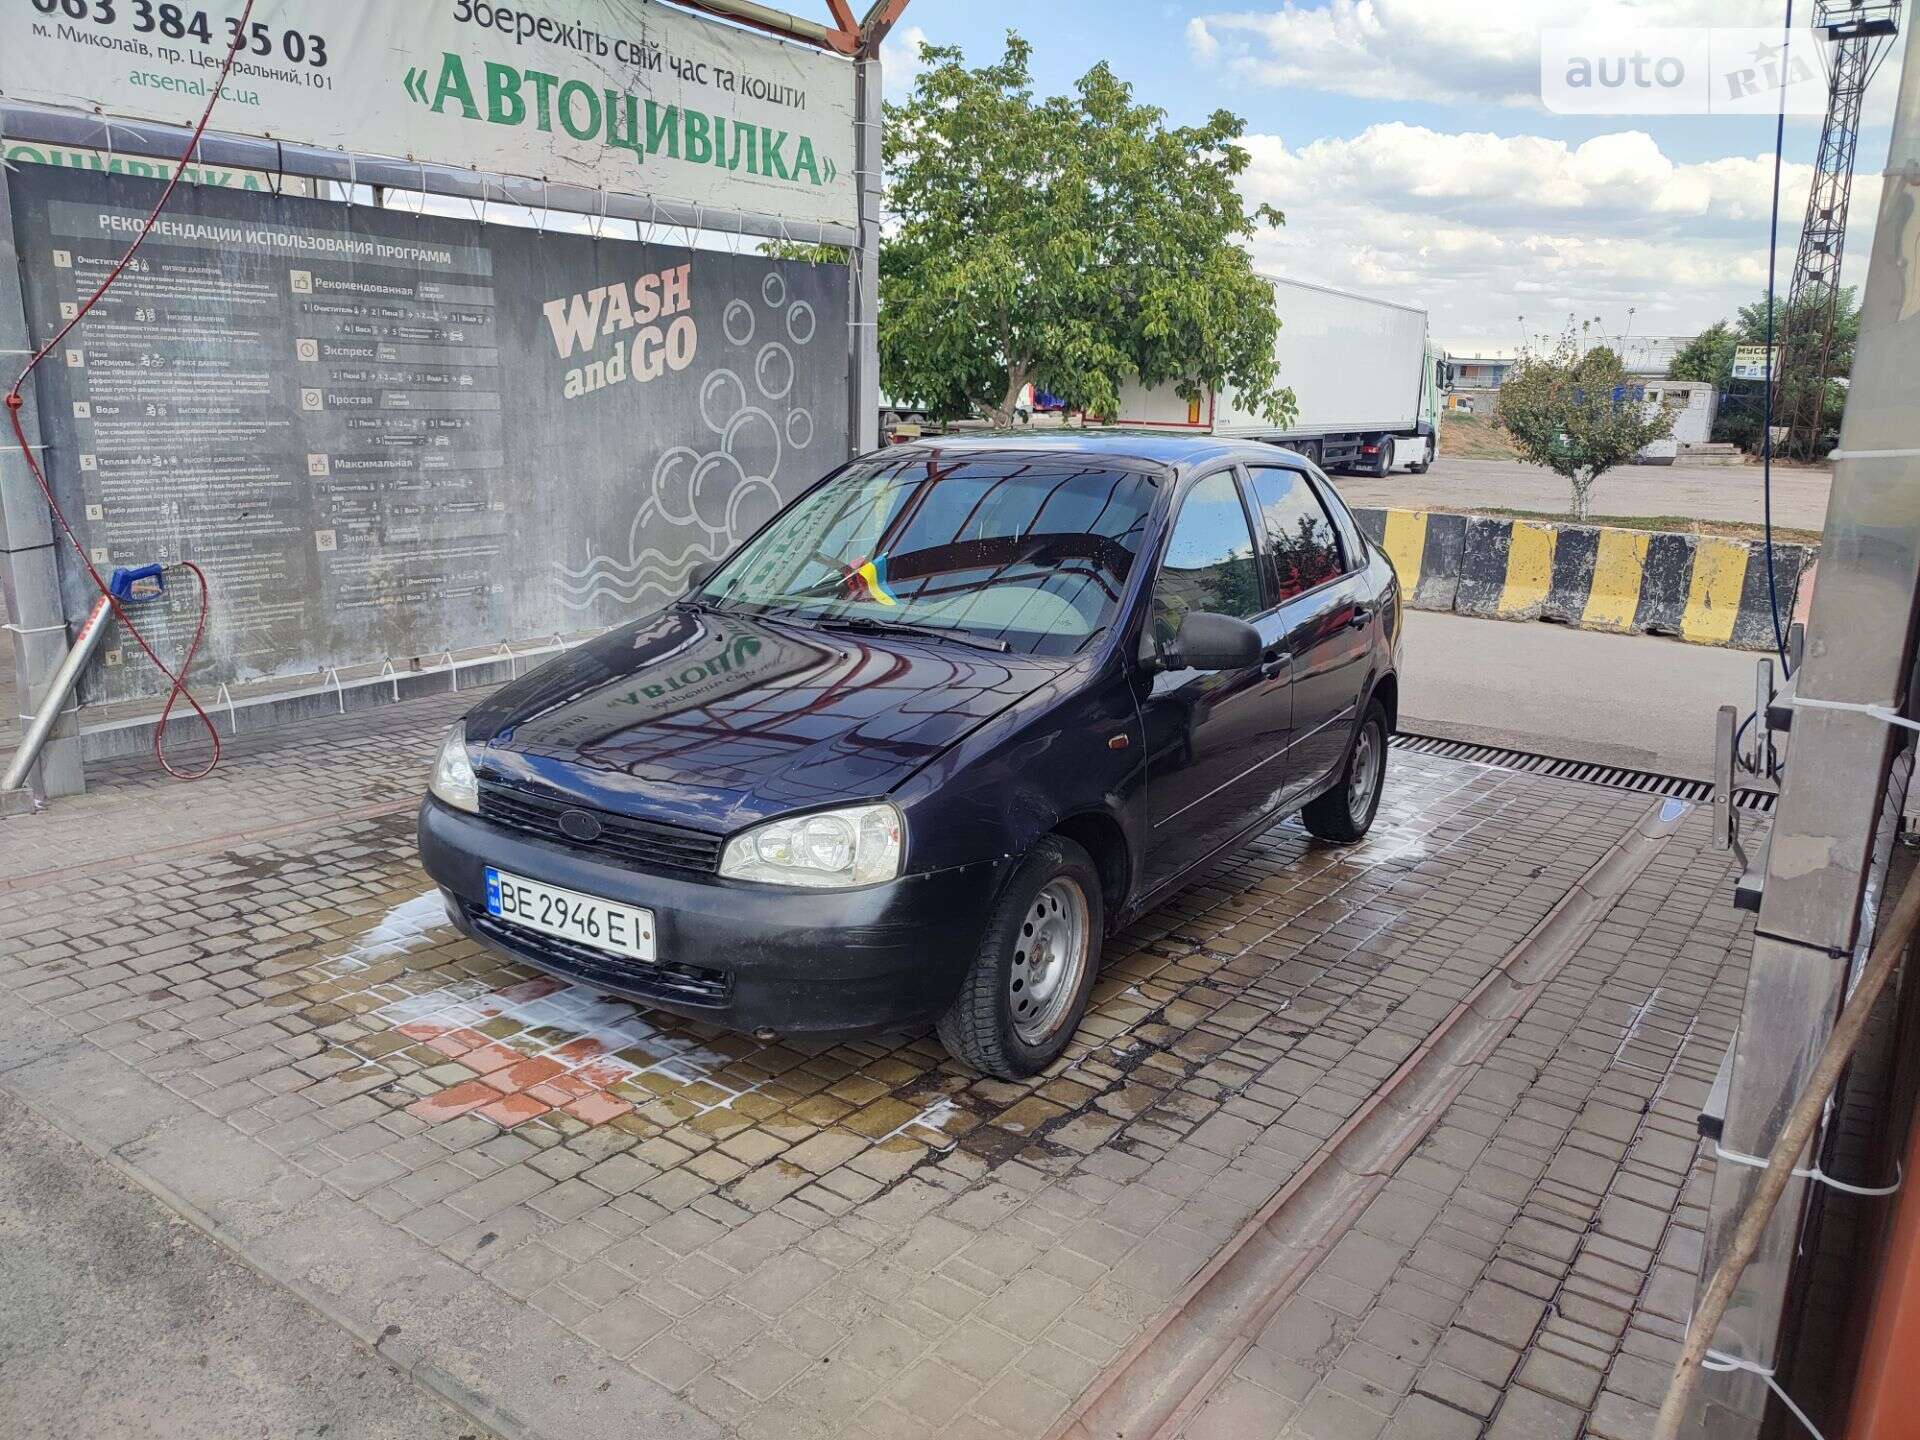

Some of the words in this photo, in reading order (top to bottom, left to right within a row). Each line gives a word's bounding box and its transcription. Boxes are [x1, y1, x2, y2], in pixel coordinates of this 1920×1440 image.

[32, 23, 51, 37] м.
[57, 23, 153, 57] Миколаїв,
[158, 47, 185, 64] пр.
[132, 0, 213, 44] 384
[225, 17, 272, 56] 35
[283, 30, 328, 67] 03
[453, 0, 609, 57] Збережіть
[614, 39, 662, 74] свій
[669, 55, 707, 86] час
[714, 68, 736, 92] та
[741, 75, 806, 111] кошти
[403, 52, 837, 187] «АВТОЦИВІЛКА»
[77, 255, 129, 267] Очиститеь
[98, 214, 242, 243] РЕКОМЕНДАЦИИ
[245, 230, 374, 256] ИСПОЛЬЗОВАНИЯ
[376, 244, 451, 265] ПРОГРАММ
[315, 277, 414, 296] Рекомендованная
[543, 263, 691, 360] WASH
[323, 345, 374, 357] Экспресс
[563, 340, 627, 399] and
[631, 315, 698, 383] GO
[96, 405, 120, 415] Вода
[328, 394, 374, 405] Простая
[334, 459, 413, 469] Максимальная
[540, 893, 600, 938] 2946
